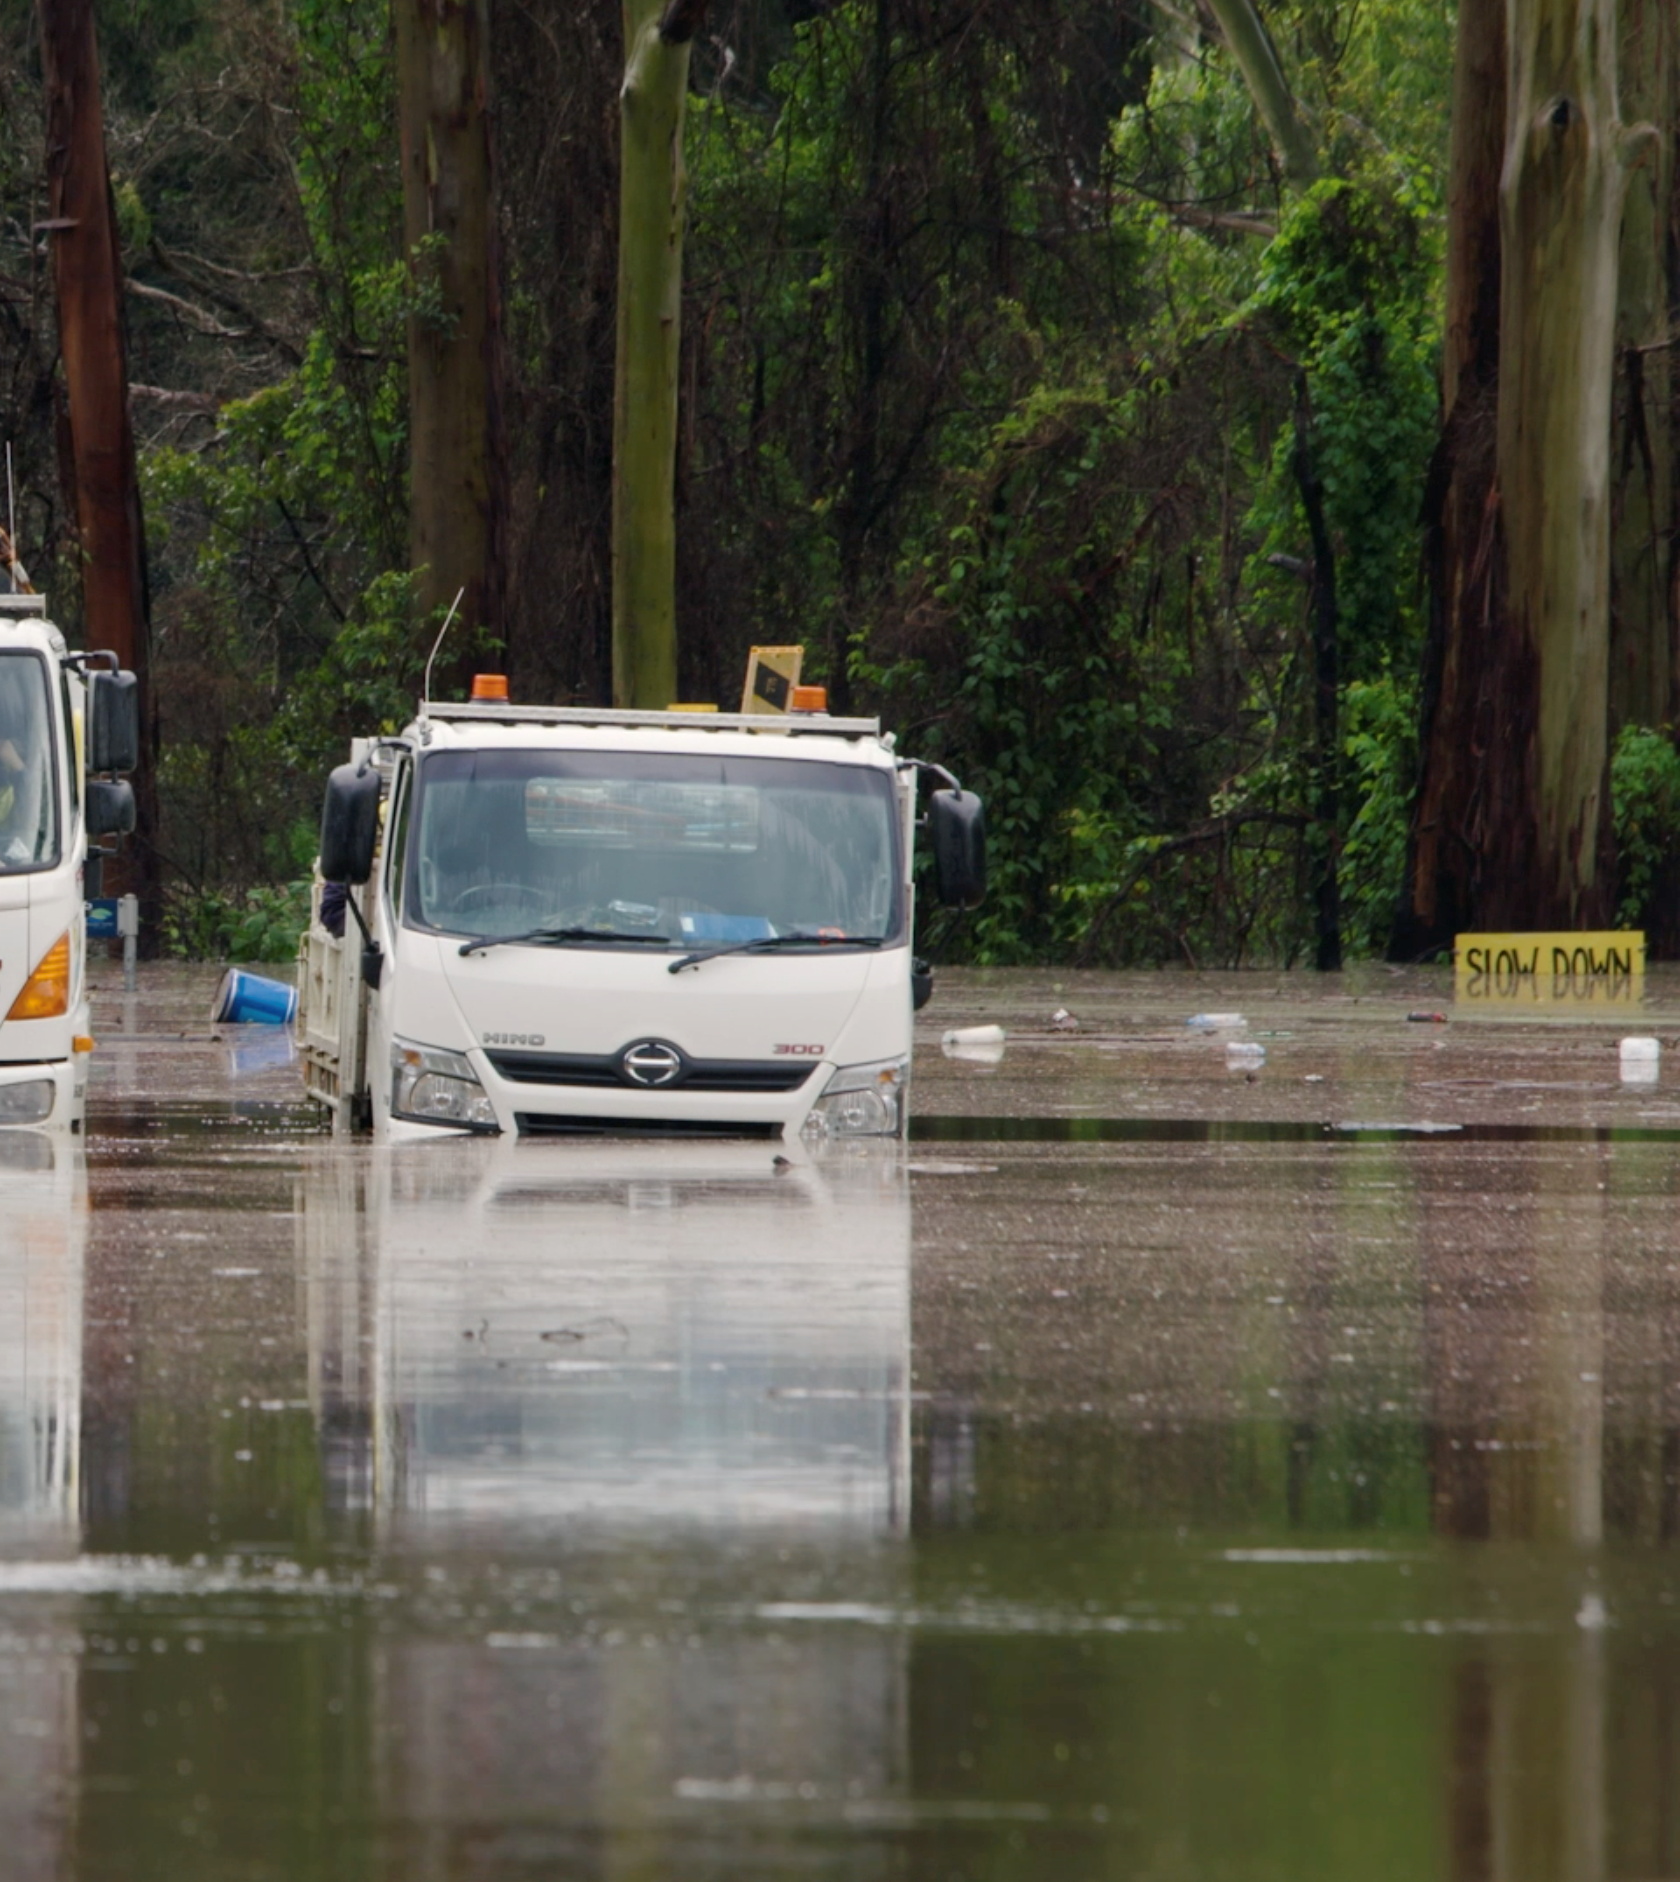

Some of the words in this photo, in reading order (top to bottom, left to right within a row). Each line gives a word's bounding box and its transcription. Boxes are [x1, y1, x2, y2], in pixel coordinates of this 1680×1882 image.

[1466, 946, 1540, 975] SLOW
[1552, 946, 1632, 975] DOWN
[482, 1032, 546, 1047] HINO
[772, 1043, 825, 1056] 300
